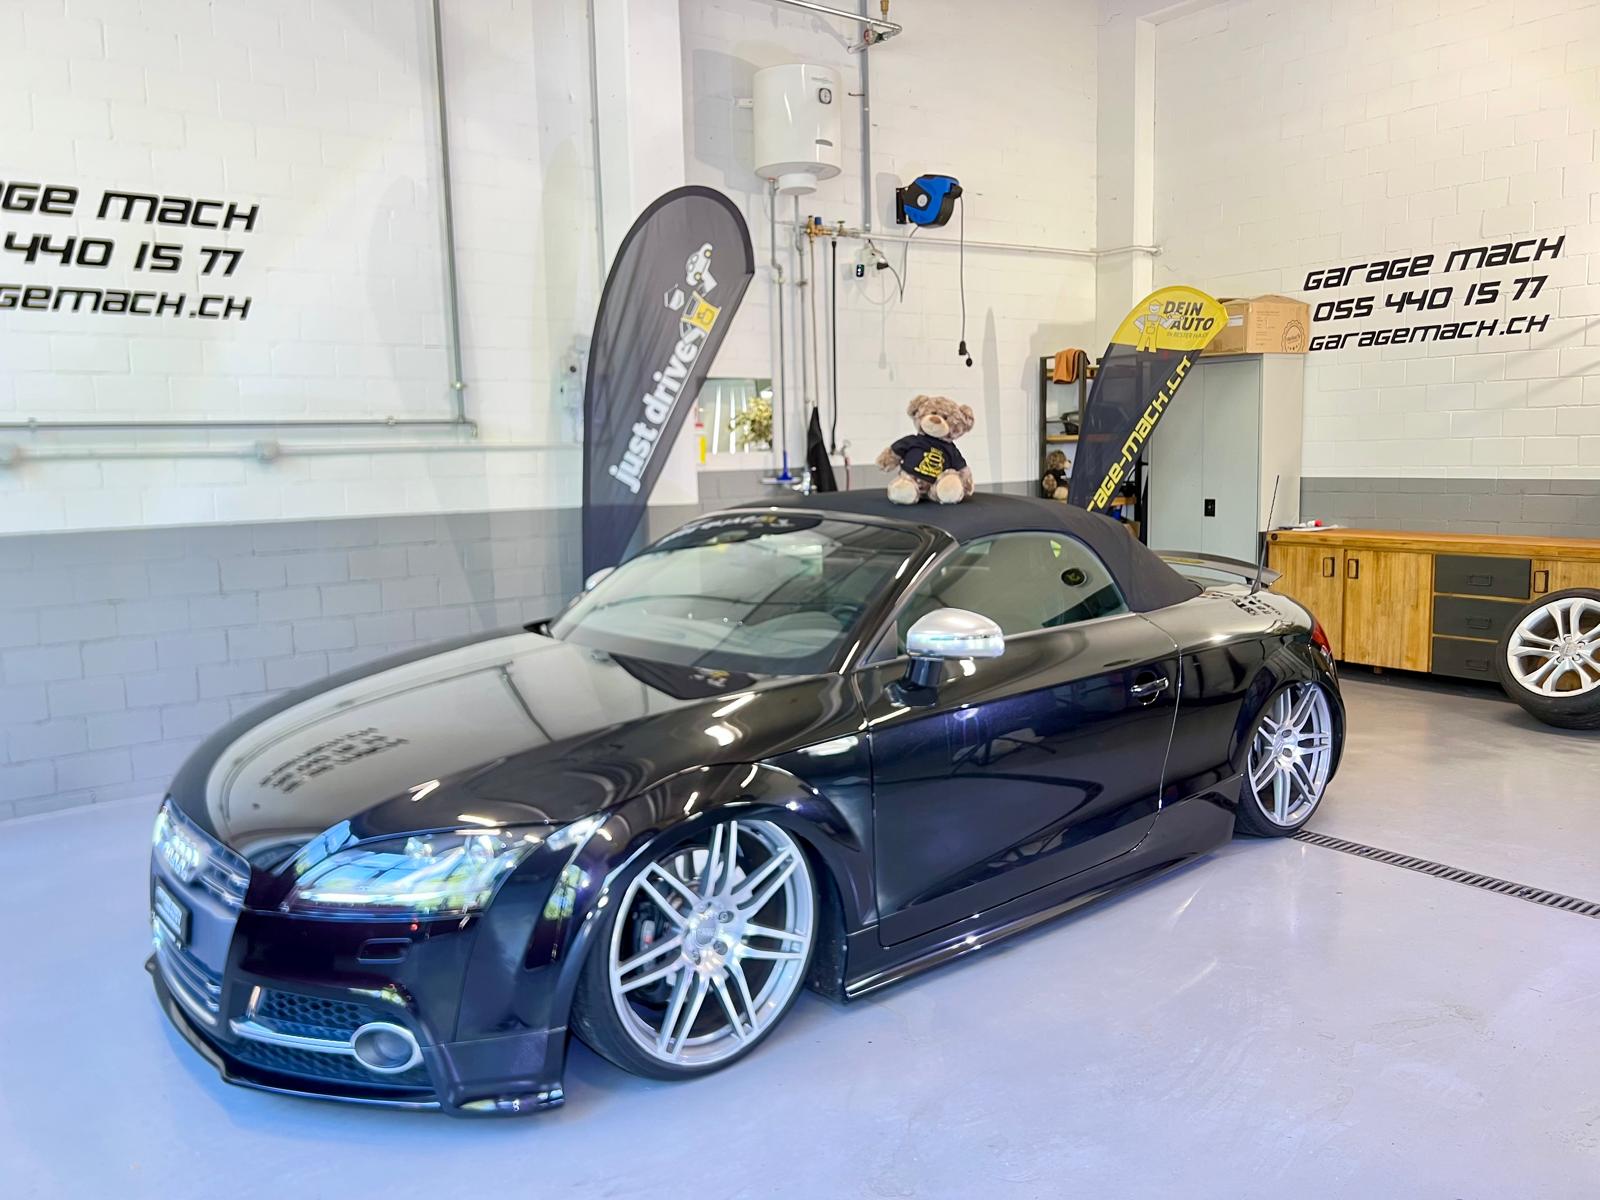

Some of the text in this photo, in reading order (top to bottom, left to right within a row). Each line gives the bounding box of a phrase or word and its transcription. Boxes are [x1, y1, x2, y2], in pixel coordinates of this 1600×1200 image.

[4, 231, 244, 277] 440 15 77
[1163, 301, 1204, 317] DEIN
[1313, 275, 1549, 322] 055 440 15 77
[1169, 317, 1215, 332] AUTO
[608, 422, 658, 494] just
